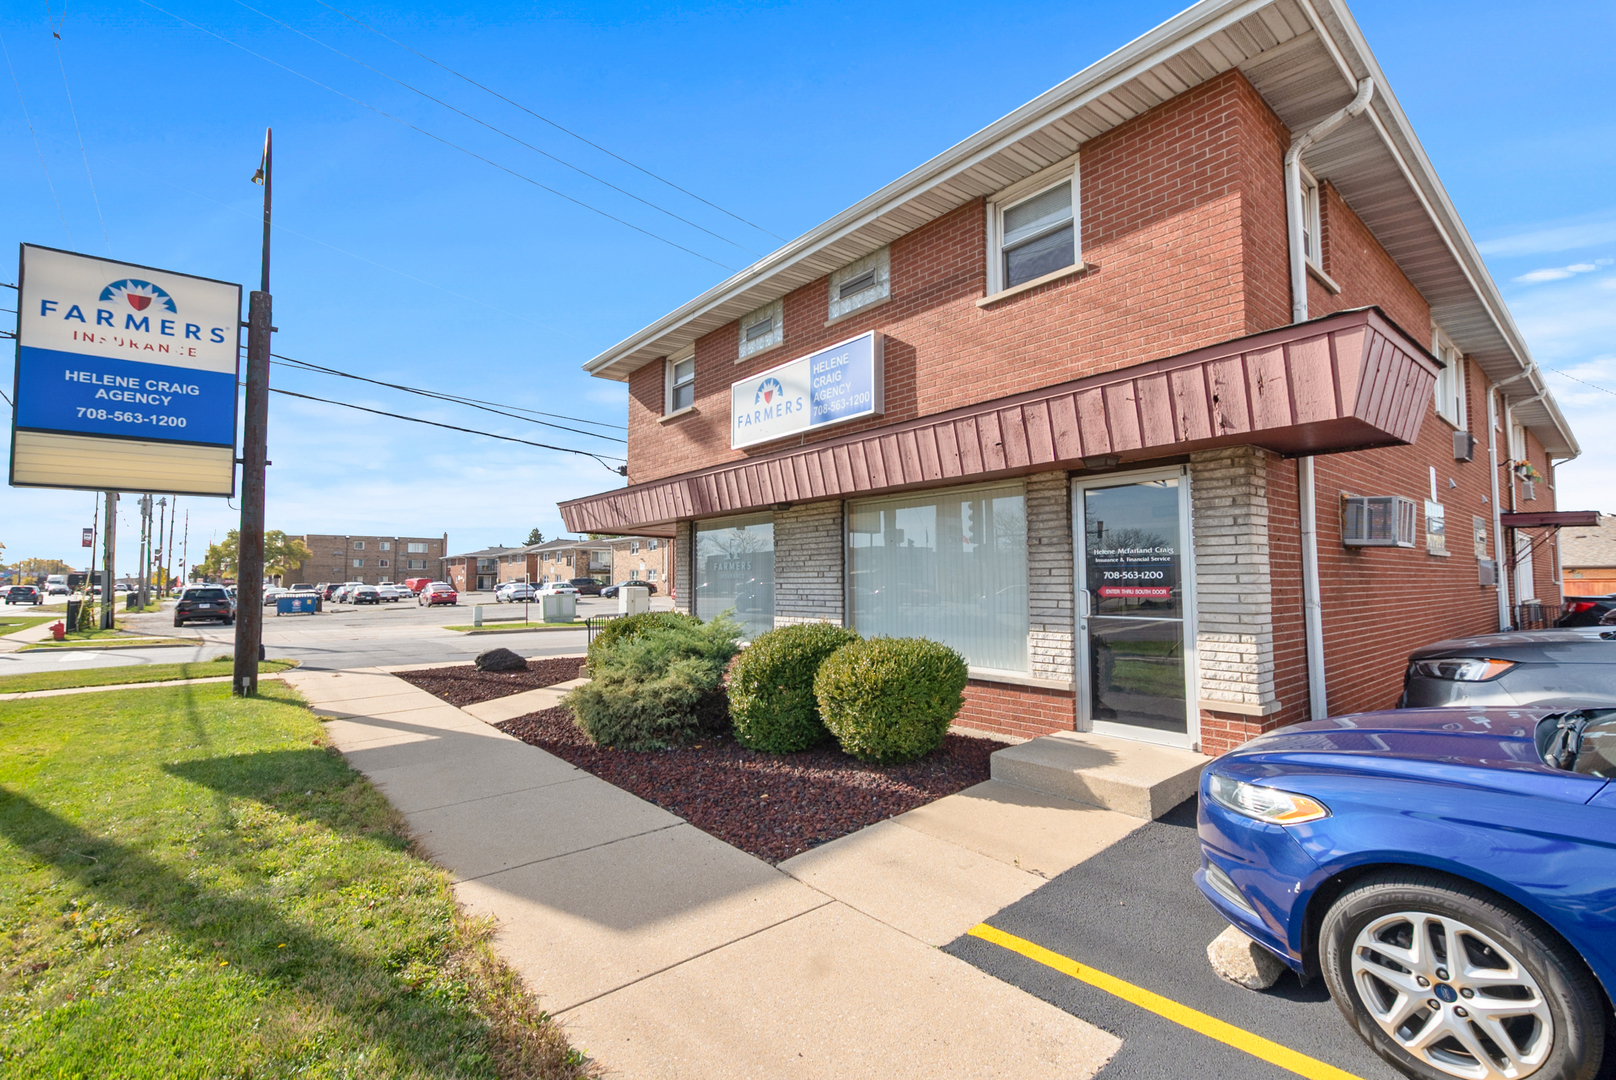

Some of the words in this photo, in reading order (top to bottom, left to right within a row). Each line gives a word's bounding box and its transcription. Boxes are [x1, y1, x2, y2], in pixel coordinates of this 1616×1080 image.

[40, 299, 226, 344] FARMERS
[813, 353, 849, 375] HELENE
[65, 370, 140, 389] HELENE
[145, 380, 200, 395] CRAIG
[813, 371, 842, 389] CRAIG
[95, 389, 172, 406] AGENCY
[813, 382, 851, 403] AGENCY
[738, 397, 803, 429] FARMERS
[813, 391, 870, 417] 708-563-1200
[76, 407, 187, 428] 708-563-1200
[1155, 547, 1174, 555] Craig
[714, 561, 751, 571] FARMERS
[1104, 571, 1163, 579] 708-563-1200
